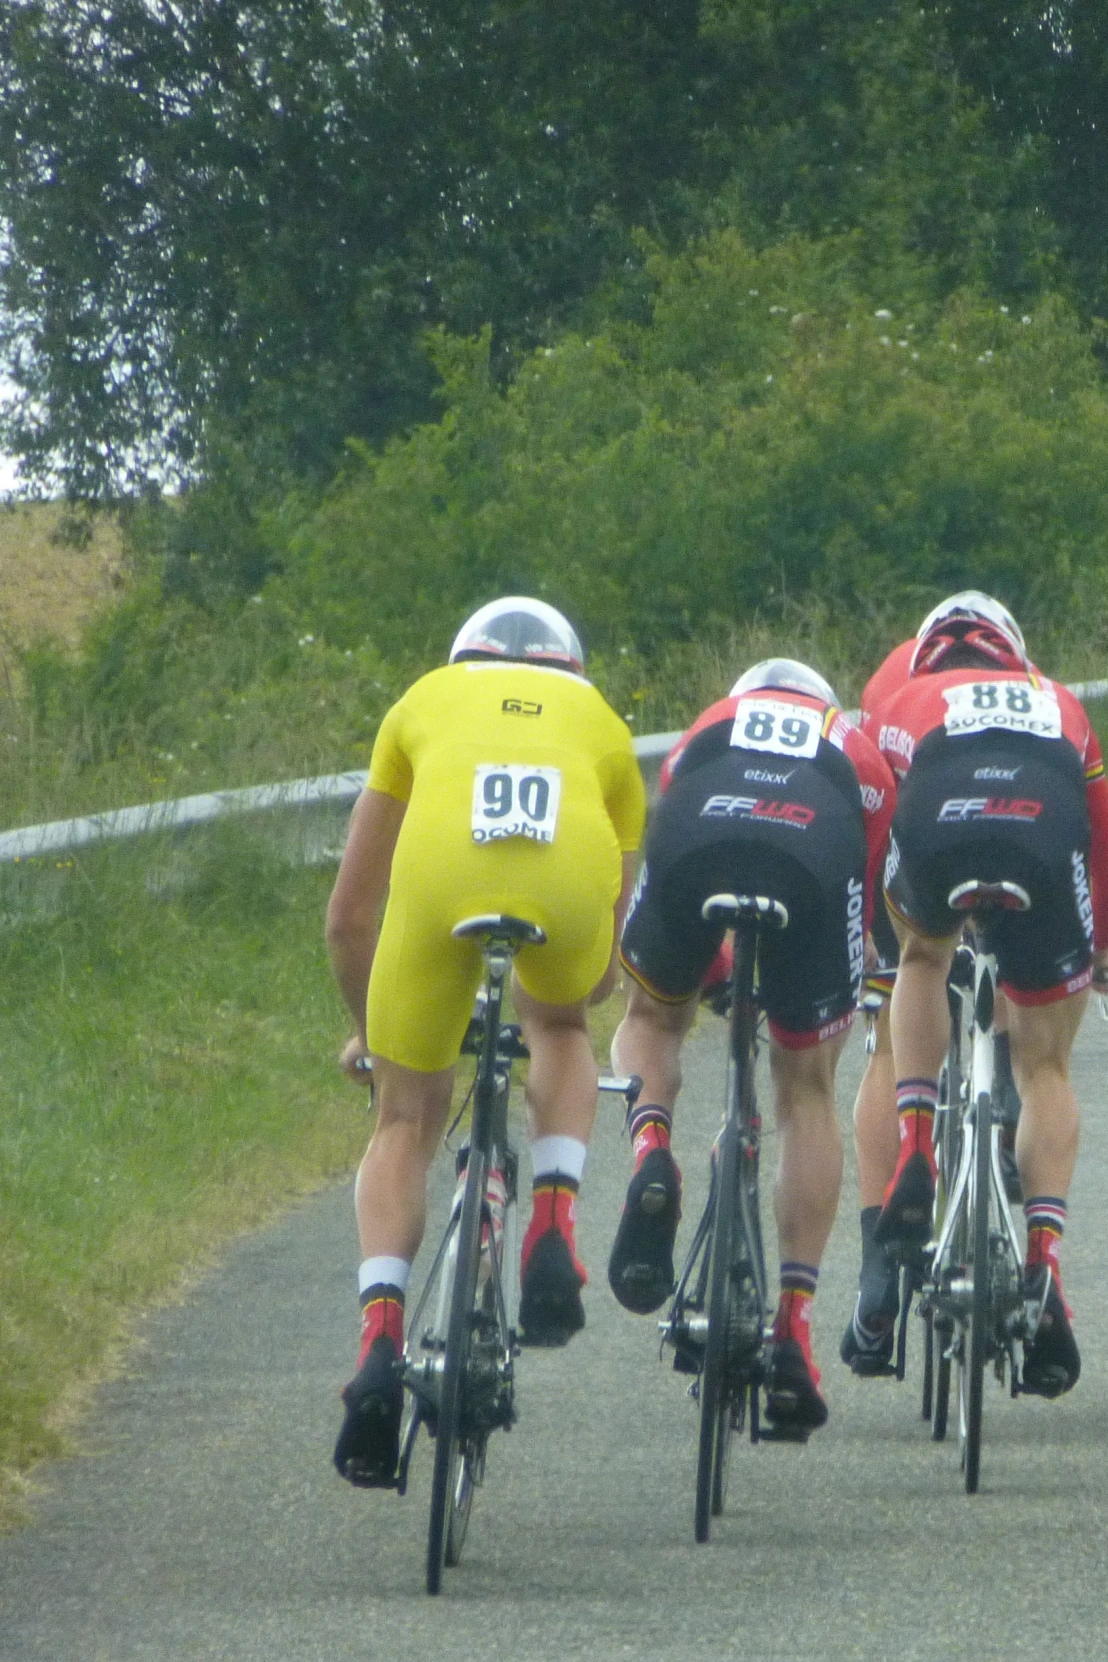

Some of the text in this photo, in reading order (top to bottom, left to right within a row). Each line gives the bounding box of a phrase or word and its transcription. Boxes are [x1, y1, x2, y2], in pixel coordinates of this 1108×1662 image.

[972, 684, 1032, 714] 88
[744, 711, 811, 748] 89
[950, 716, 1054, 734] SOCOMEX
[483, 773, 550, 822] 90
[702, 795, 817, 825] FFWD
[938, 798, 1044, 818] FFWD
